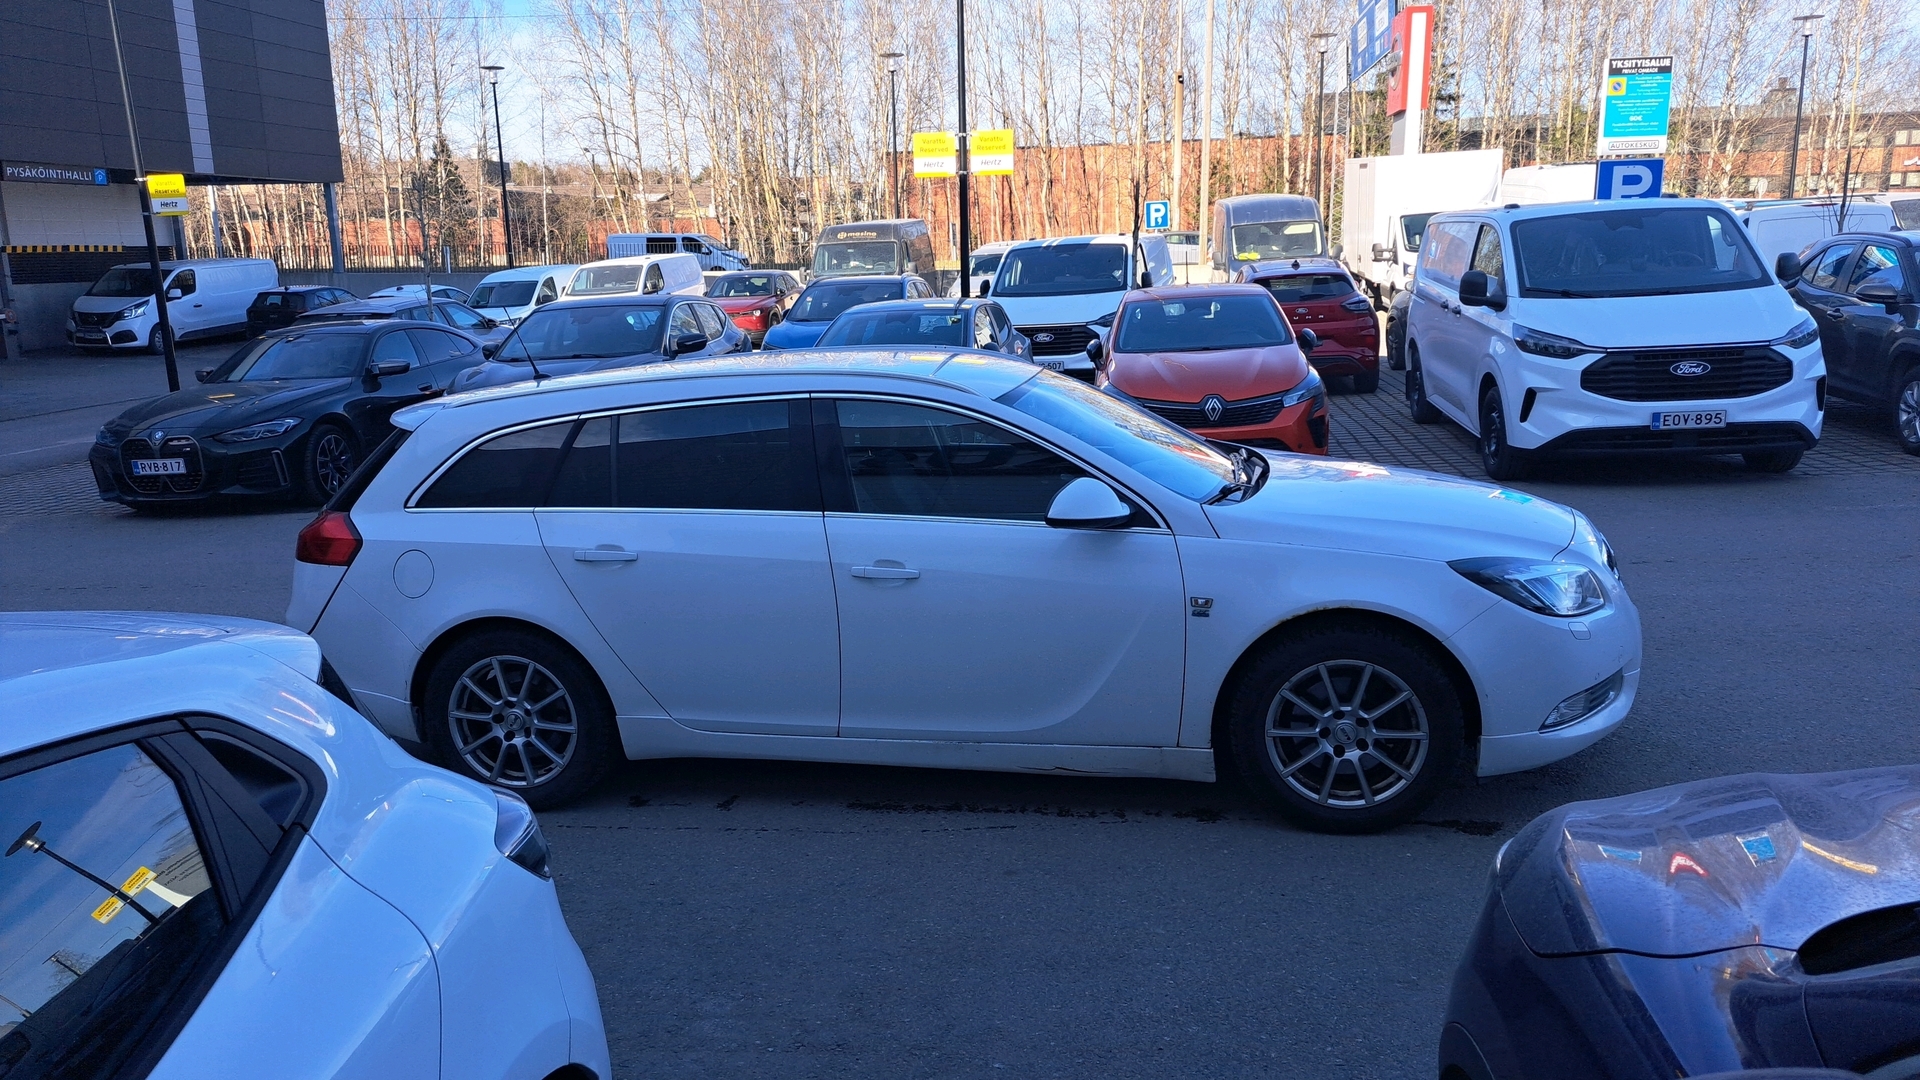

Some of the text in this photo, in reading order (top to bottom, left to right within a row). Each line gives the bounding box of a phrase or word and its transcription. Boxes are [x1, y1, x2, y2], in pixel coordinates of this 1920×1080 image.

[1611, 58, 1671, 68] YKSITYISALUE
[7, 166, 91, 180] PYSÄKÖINTIHALLI
[1611, 165, 1652, 199] P
[1150, 203, 1166, 227] P
[1677, 363, 1704, 374] Ford
[1662, 412, 1723, 426] EOV-895
